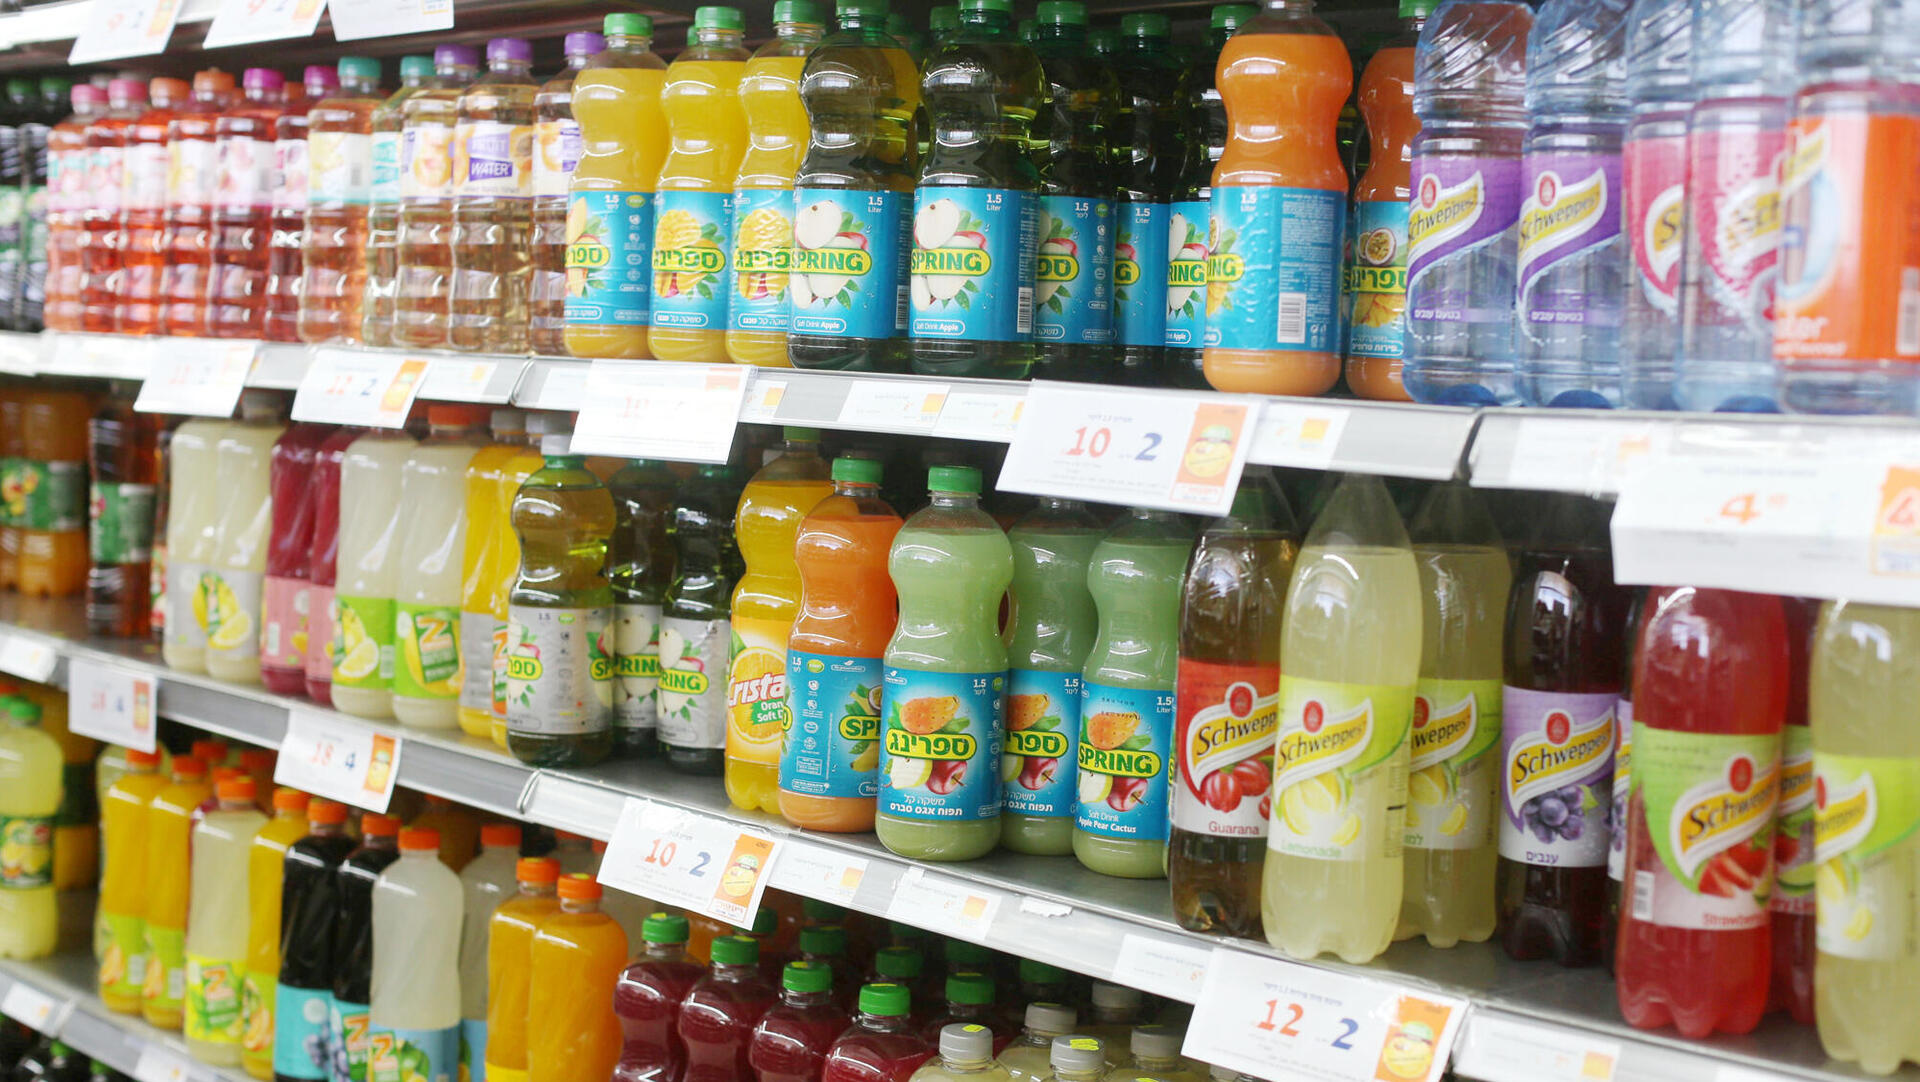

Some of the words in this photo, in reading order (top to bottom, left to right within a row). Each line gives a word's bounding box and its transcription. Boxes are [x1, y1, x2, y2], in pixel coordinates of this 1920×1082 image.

[471, 162, 509, 177] WATER
[868, 196, 882, 206] 1.5
[986, 194, 1002, 204] 1.5
[1241, 193, 1257, 204] 1.5
[1075, 202, 1089, 212] 1.5
[1135, 207, 1150, 217] 1.5
[735, 248, 790, 269] פרינג
[791, 252, 863, 271] SPRING
[911, 252, 982, 271] SPRING
[1168, 263, 1205, 282] RING
[1435, 310, 1461, 319] בטעם
[1556, 312, 1585, 322] בטעם
[820, 321, 840, 330] Apple
[939, 324, 959, 333] Apple
[1065, 426, 1112, 458] 10
[1135, 433, 1162, 461] 2
[1720, 494, 1760, 524] 4
[792, 657, 802, 666] 1.5
[661, 673, 701, 691] RING
[973, 679, 986, 688] 1.5
[1064, 678, 1079, 688] 1.5
[729, 673, 785, 707] Crista
[761, 701, 784, 711] Oran
[1157, 696, 1172, 706] 1.5
[757, 712, 777, 723] Soft
[1197, 712, 1278, 757] Schwepp
[1412, 720, 1467, 750] weppes
[890, 733, 970, 756] ספרינג
[1006, 732, 1061, 755] ספרי
[1277, 726, 1363, 771] Schweppes
[1079, 748, 1153, 774] SPRING
[1515, 735, 1608, 784] Schweppes
[904, 794, 916, 804] קל
[918, 795, 945, 806] משקה
[1010, 791, 1036, 801] משקה
[890, 803, 912, 813] סברס
[915, 805, 935, 815] אגס
[937, 806, 963, 815] תפוח
[1008, 800, 1027, 811] אגס
[1028, 802, 1053, 812] תפוח
[1088, 809, 1099, 819] Soft
[1100, 812, 1119, 822] Drink
[1079, 816, 1093, 828] Apple
[1093, 820, 1109, 830] Pear
[1110, 824, 1137, 833] Cactus
[1209, 820, 1260, 835] Guarana
[644, 839, 677, 868] 10
[689, 851, 712, 878] 2
[1526, 850, 1560, 864] ענבים
[1257, 999, 1304, 1038] 12
[1331, 1018, 1359, 1051] 2
